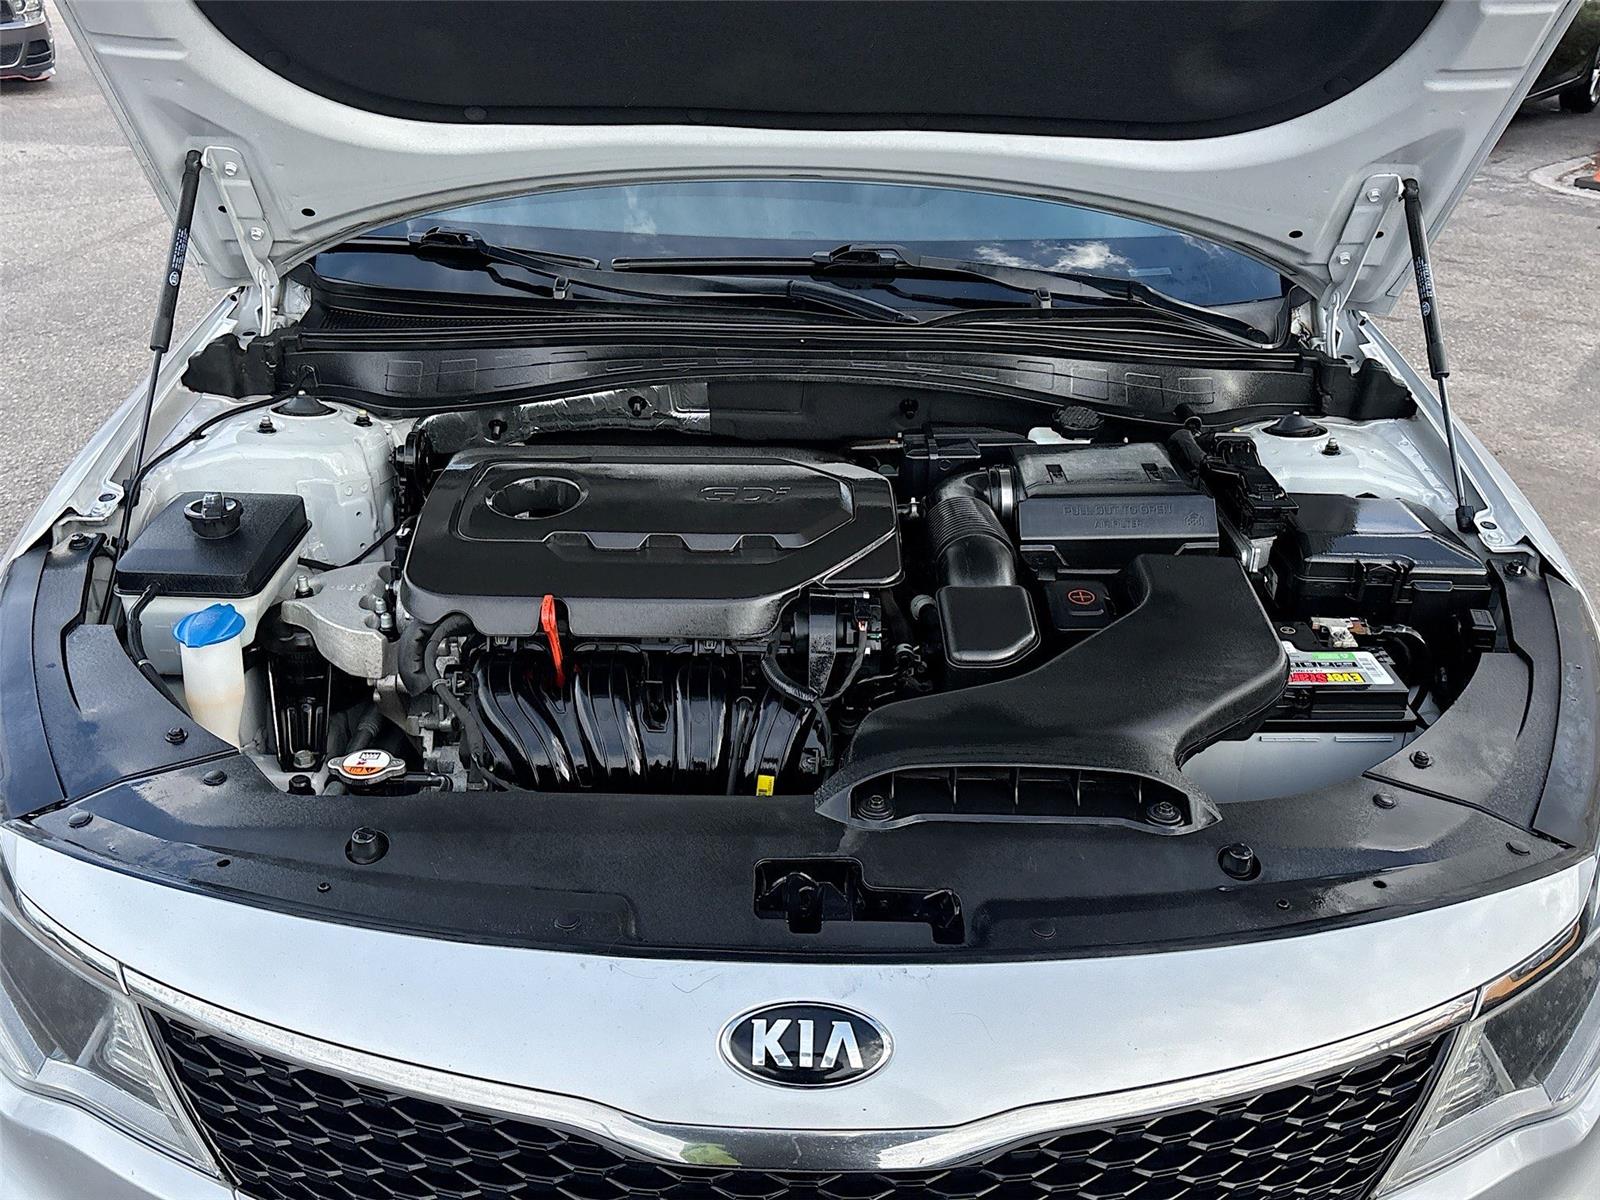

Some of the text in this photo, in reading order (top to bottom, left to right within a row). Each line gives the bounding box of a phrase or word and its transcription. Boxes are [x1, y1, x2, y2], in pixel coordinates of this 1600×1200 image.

[1063, 502, 1173, 516] PULL OUT TO OPEN
[1094, 519, 1111, 529] AIR
[751, 1019, 864, 1069] KIA
